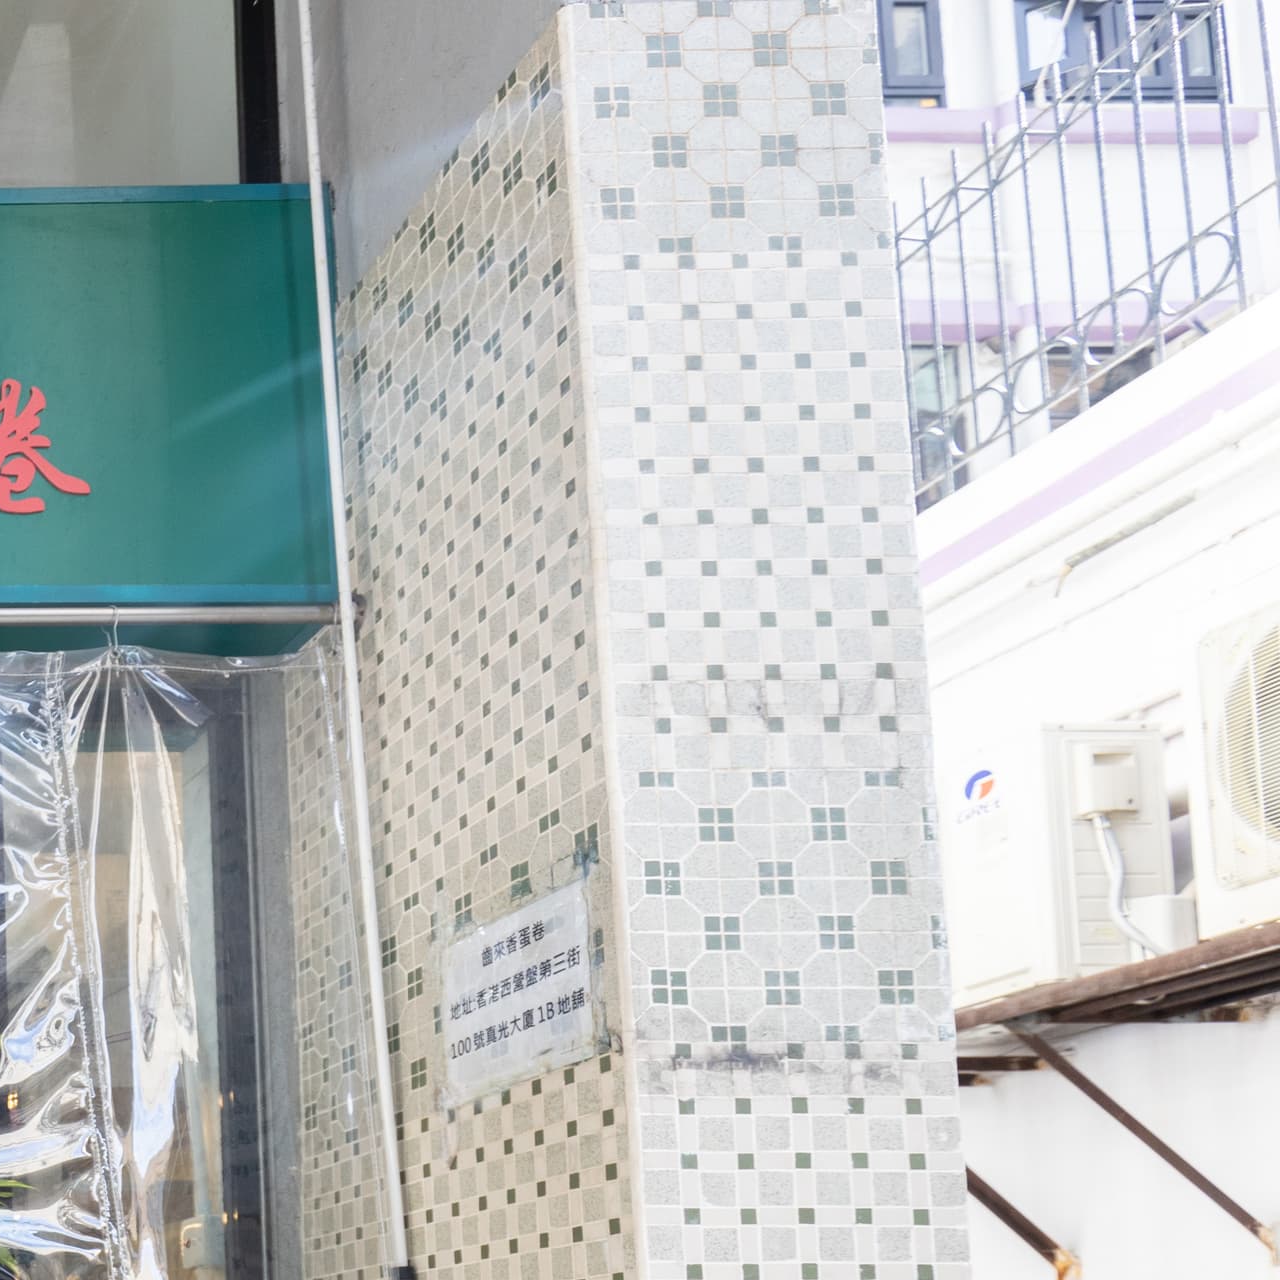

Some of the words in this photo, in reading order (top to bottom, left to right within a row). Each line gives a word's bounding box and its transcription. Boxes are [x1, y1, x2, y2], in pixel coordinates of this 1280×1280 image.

[481, 920, 546, 967] 齒來香蛋卷
